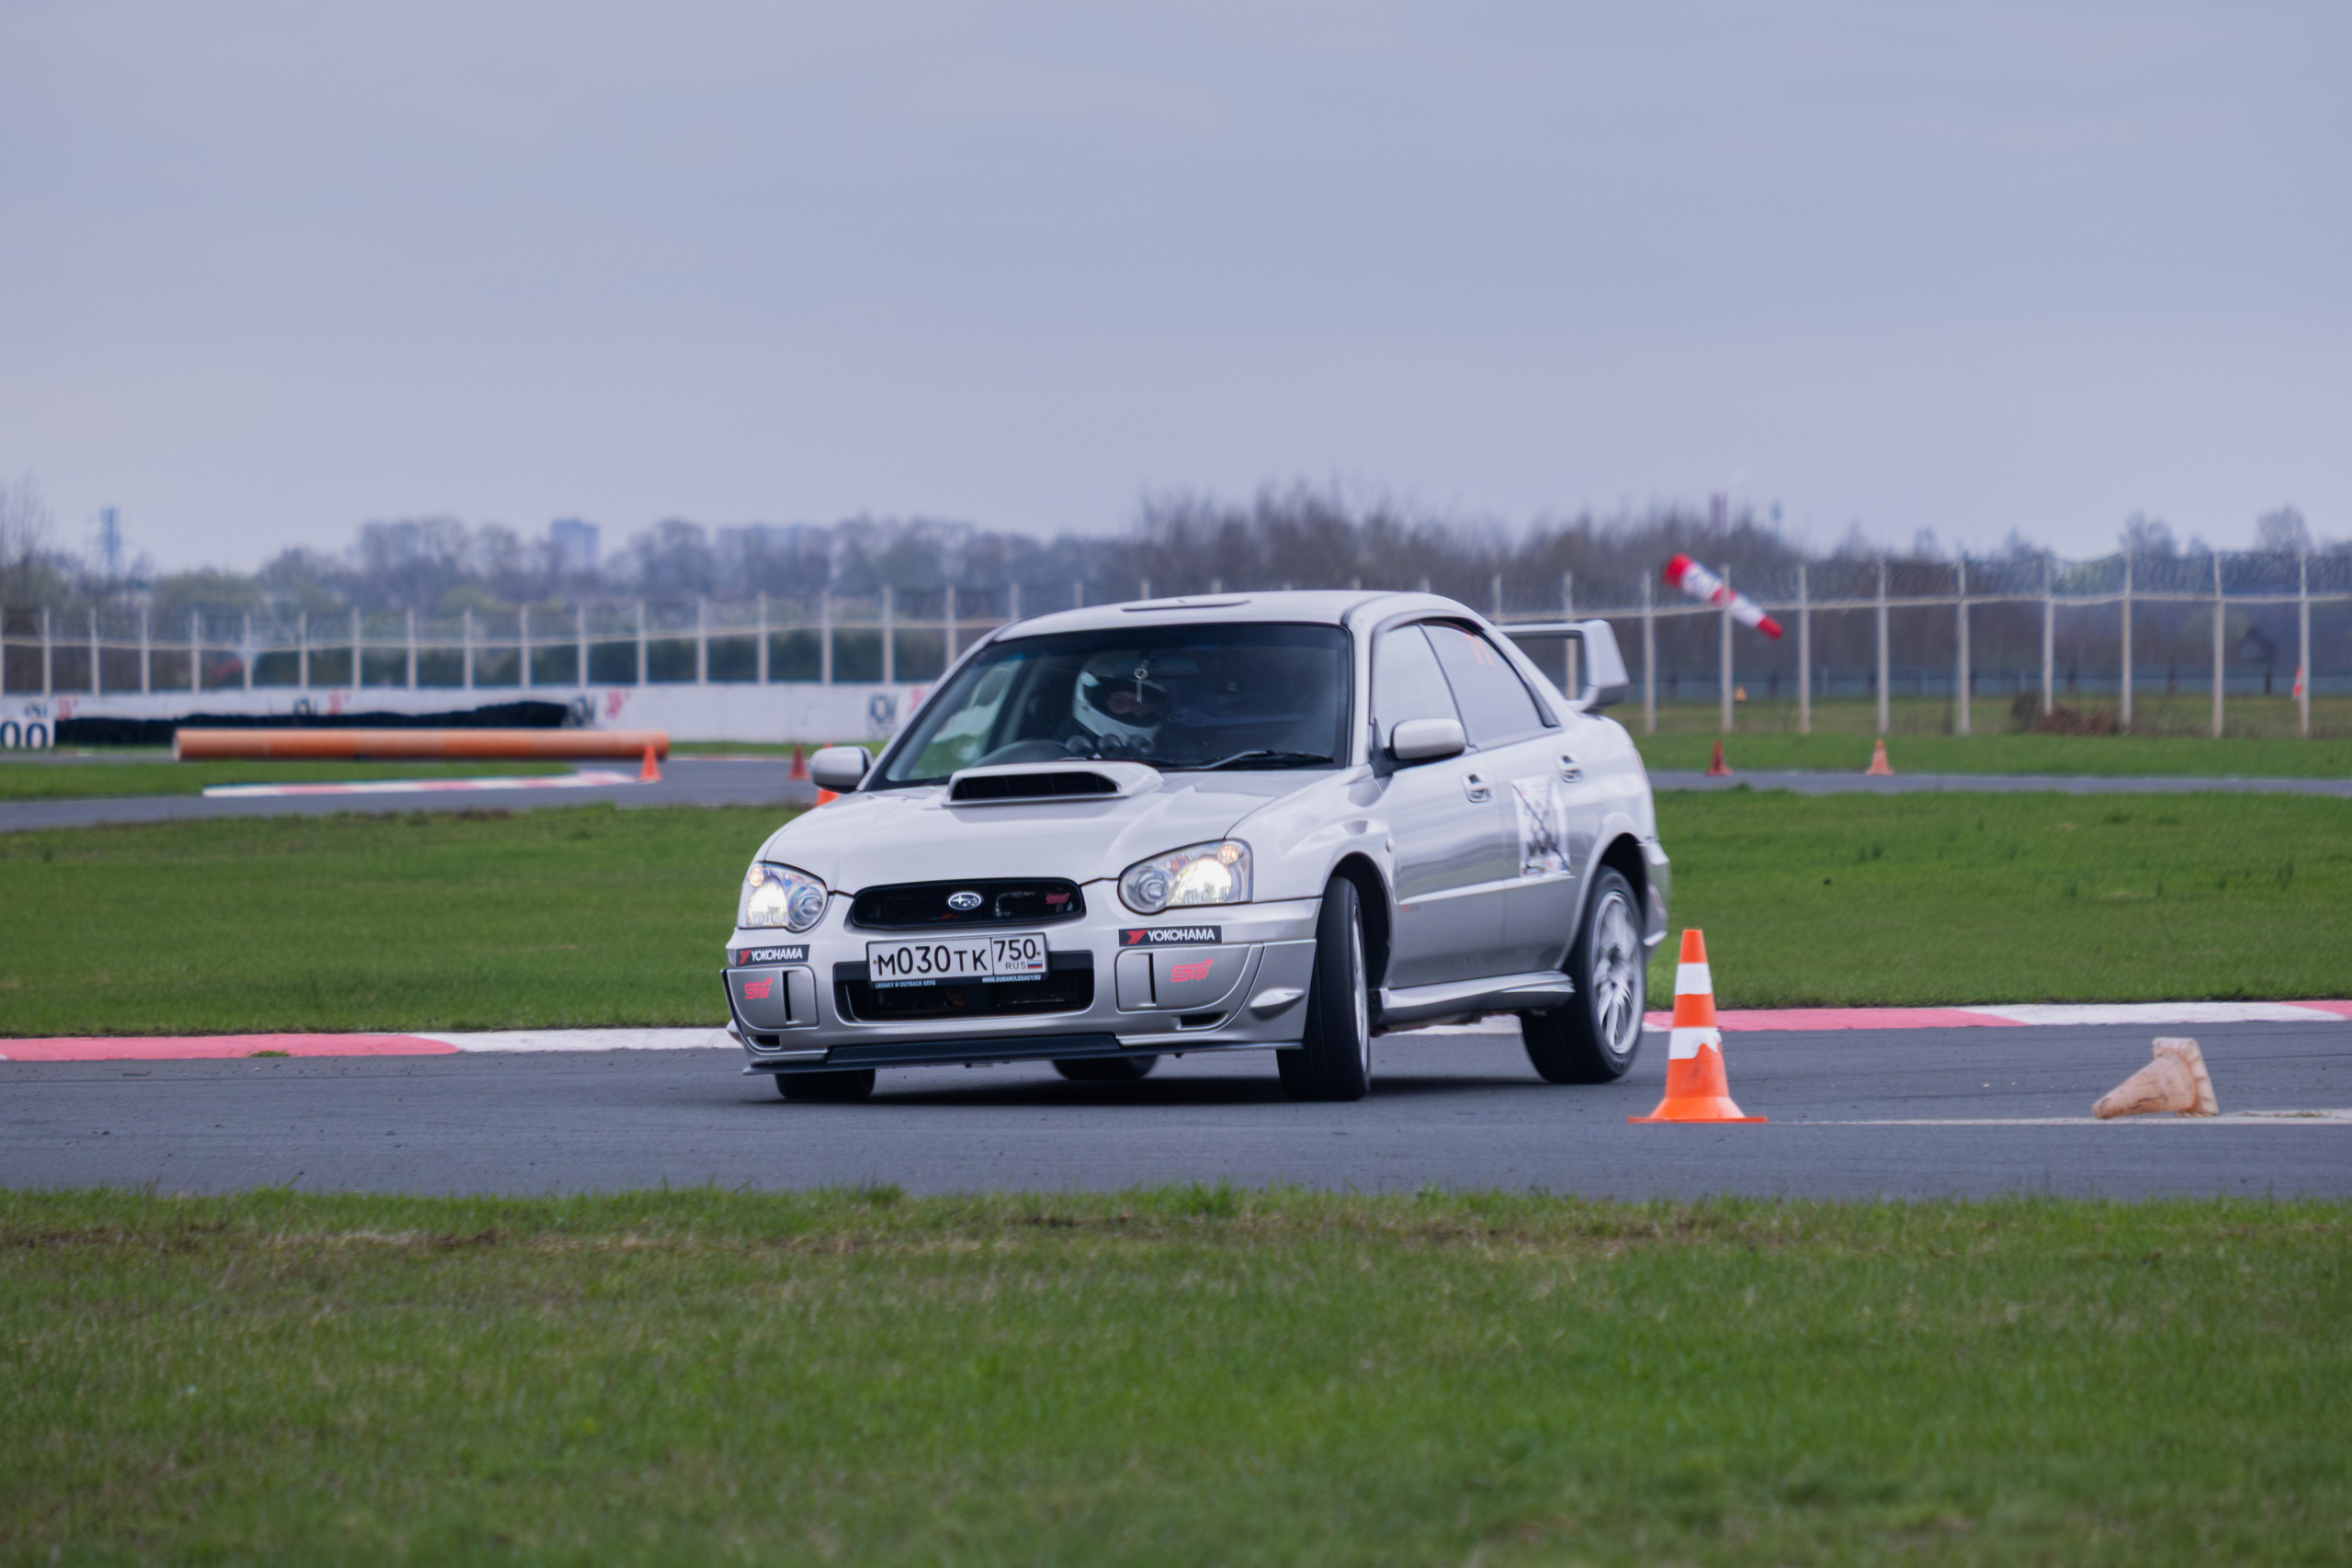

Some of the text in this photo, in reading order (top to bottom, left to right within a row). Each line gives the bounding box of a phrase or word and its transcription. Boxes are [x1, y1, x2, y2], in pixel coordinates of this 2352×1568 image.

[1147, 928, 1216, 942] YOKOHAMA
[751, 947, 803, 962] YOKOHAMA
[992, 938, 1037, 963] 750
[1005, 961, 1027, 970] RUS
